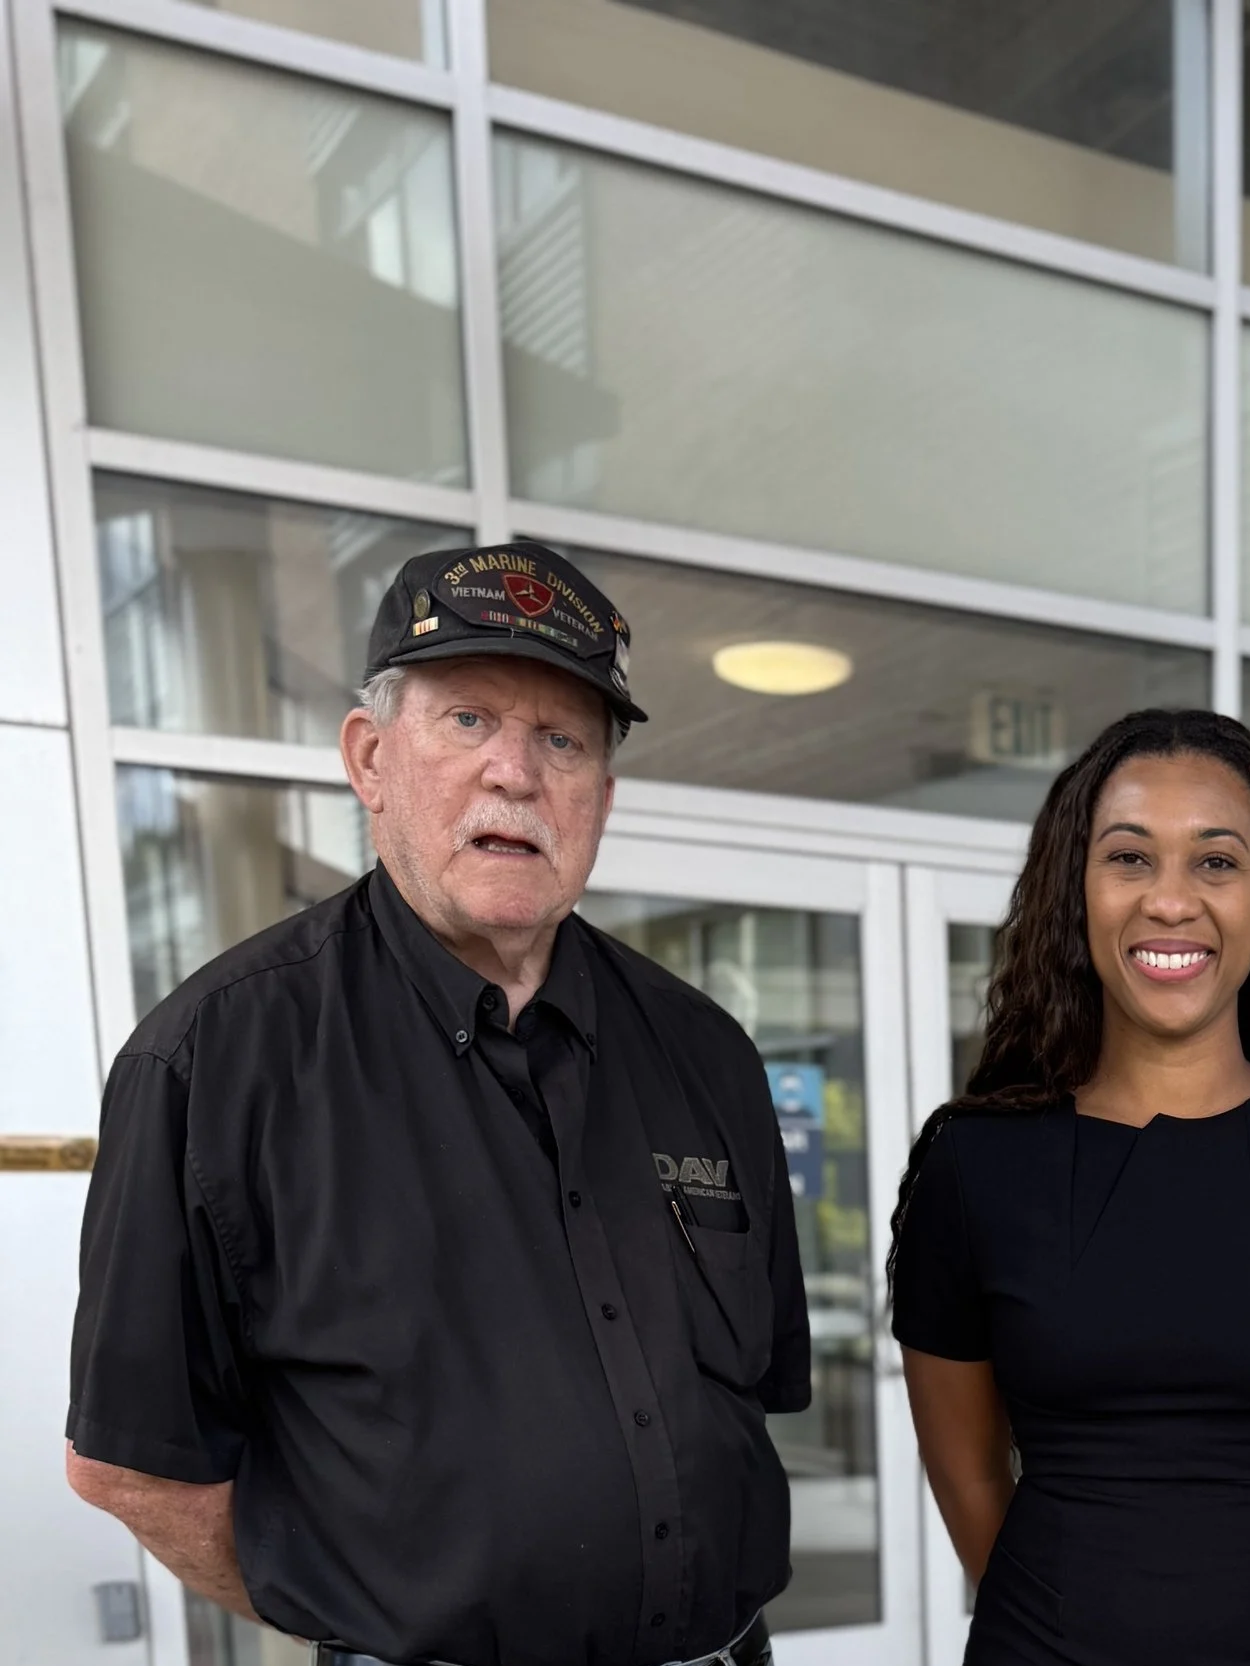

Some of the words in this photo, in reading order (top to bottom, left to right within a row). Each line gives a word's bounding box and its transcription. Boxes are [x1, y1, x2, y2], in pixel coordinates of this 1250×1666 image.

[444, 561, 470, 585] 3rd
[469, 553, 537, 577] MARINE
[546, 571, 605, 635] DIVISION
[451, 586, 506, 601] VIETNAM
[551, 606, 600, 643] VETERAN
[652, 1152, 729, 1187] DAV
